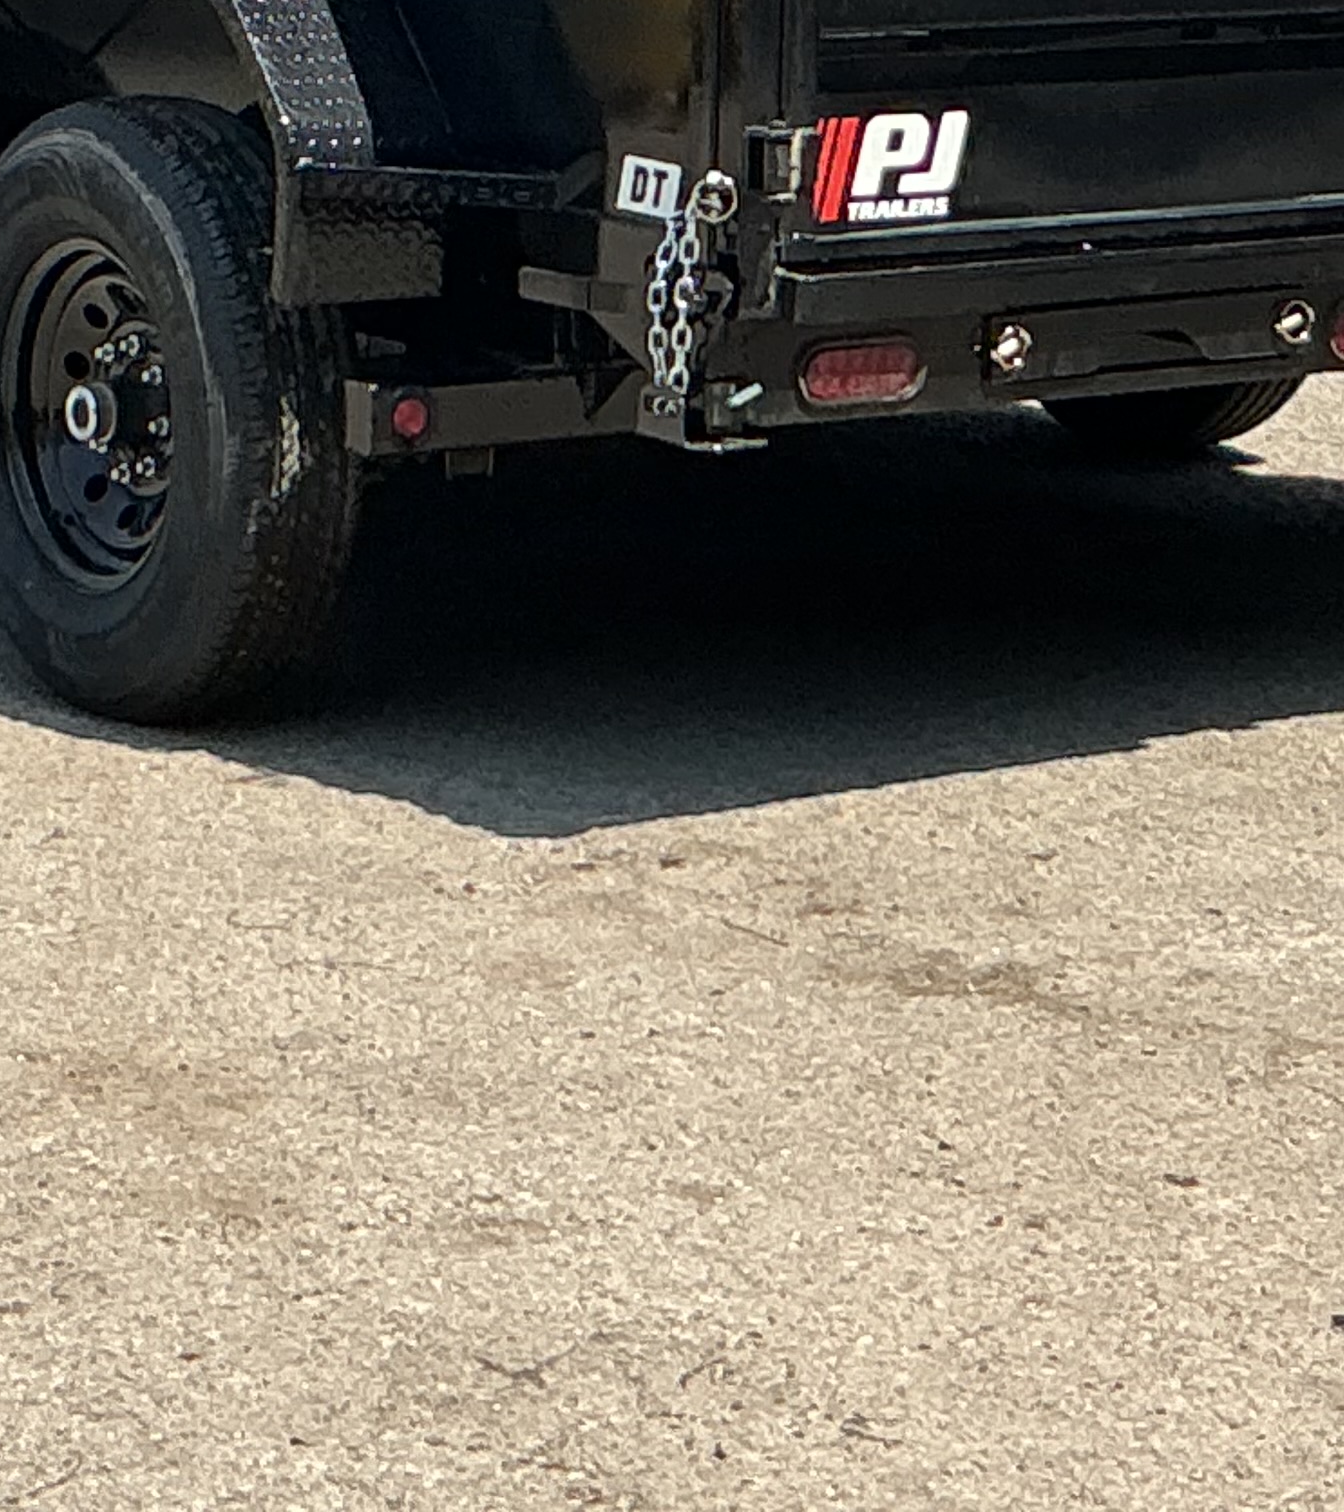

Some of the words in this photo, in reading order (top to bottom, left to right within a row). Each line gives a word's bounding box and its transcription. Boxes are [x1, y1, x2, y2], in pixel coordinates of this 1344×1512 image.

[850, 109, 969, 197] PJ
[630, 165, 669, 208] DT
[847, 196, 950, 222] TRAILERS
